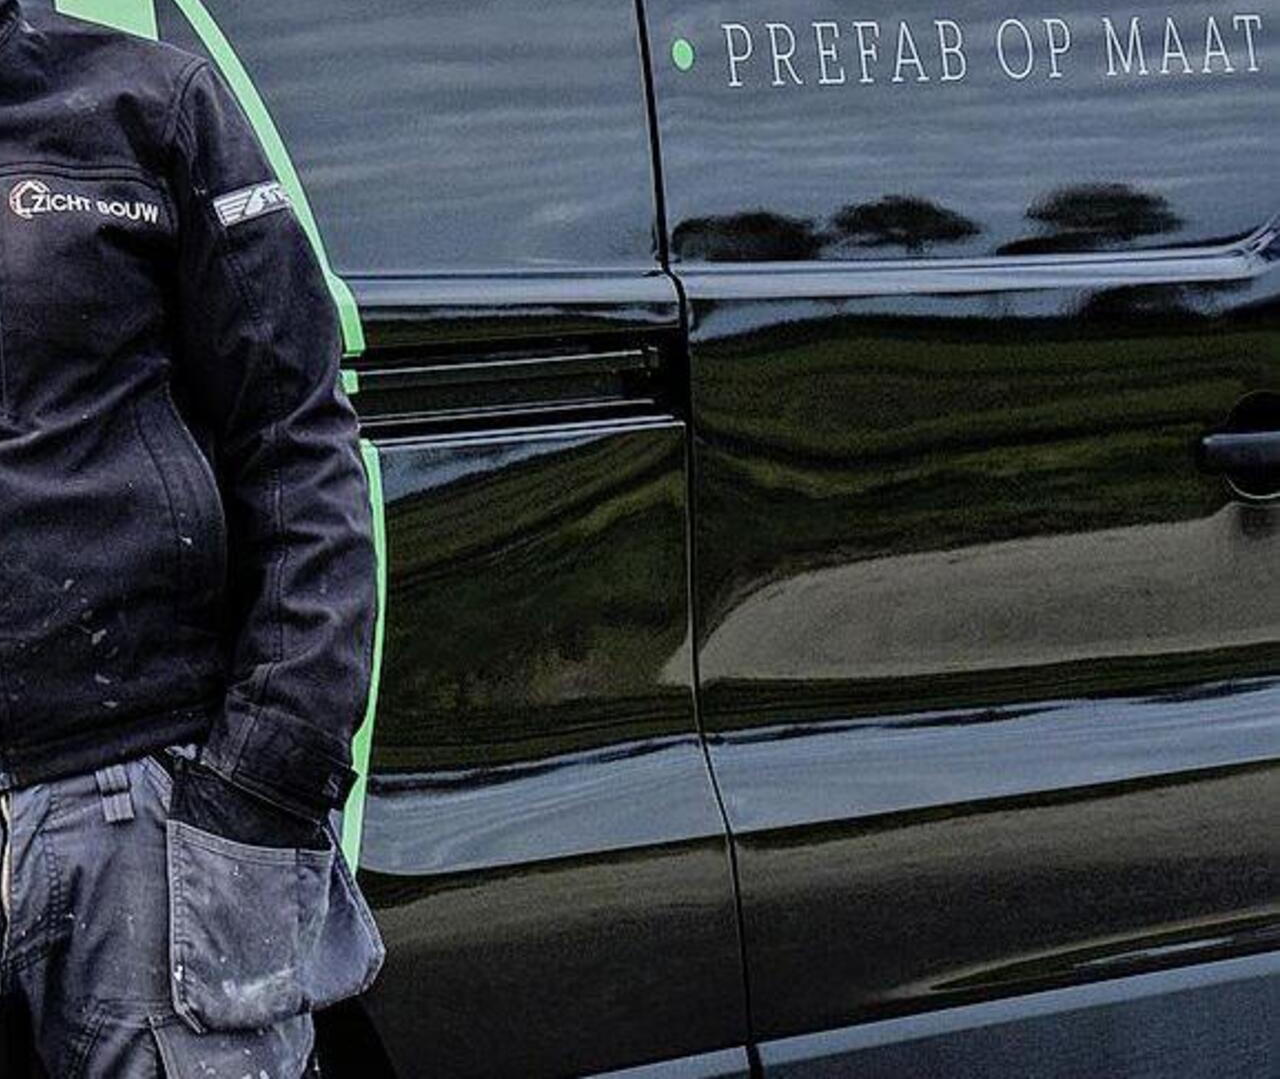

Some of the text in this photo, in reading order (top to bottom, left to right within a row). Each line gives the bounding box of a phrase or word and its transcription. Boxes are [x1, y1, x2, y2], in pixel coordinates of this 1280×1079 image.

[720, 14, 1263, 88] PREFAB OP MAAT
[31, 193, 159, 224] ZICHT BOUW
